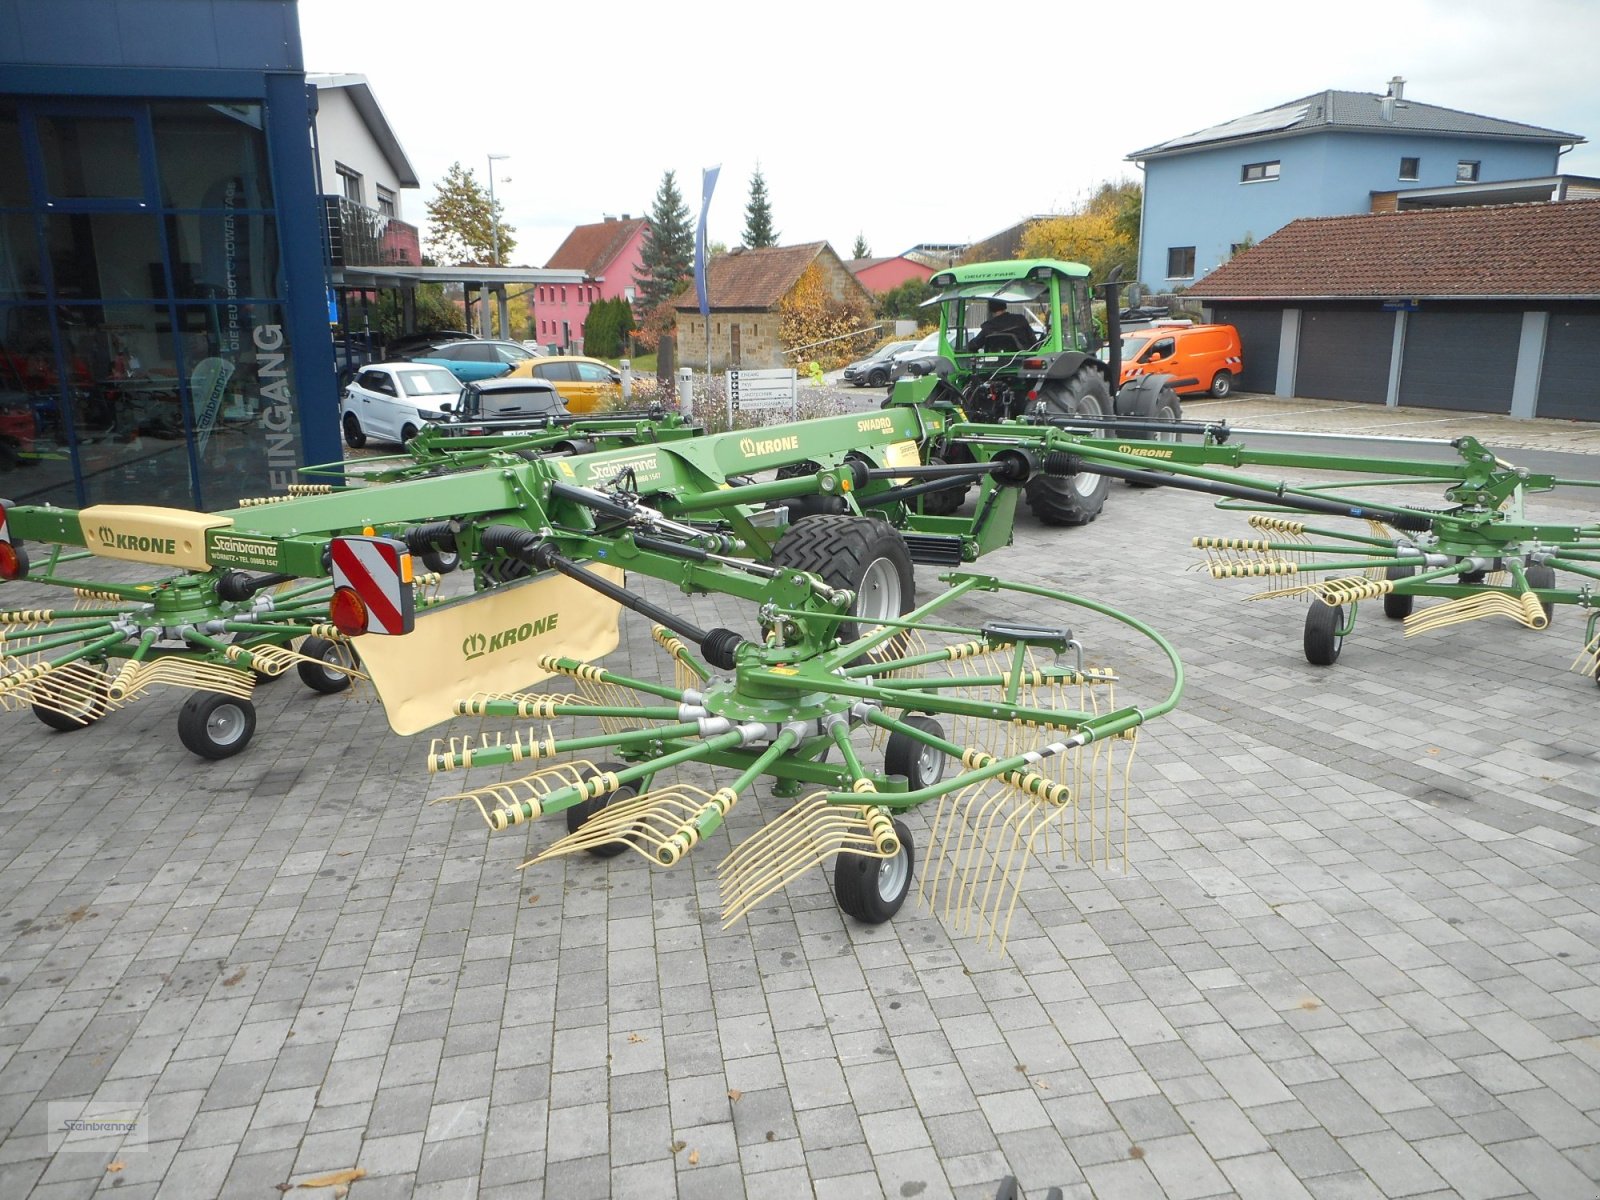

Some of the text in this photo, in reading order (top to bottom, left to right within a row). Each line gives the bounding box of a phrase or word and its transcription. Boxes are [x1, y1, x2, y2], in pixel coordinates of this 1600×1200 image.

[229, 330, 240, 350] DIE
[253, 324, 299, 491] EINGANG
[857, 416, 892, 433] SWADRO
[755, 435, 799, 456] KRONE
[1131, 448, 1173, 458] KRONE
[117, 533, 176, 555] KRONE
[210, 535, 278, 557] Steinbrenner
[240, 555, 250, 564] TEL
[266, 559, 279, 567] 1547
[489, 613, 559, 653] KRONE
